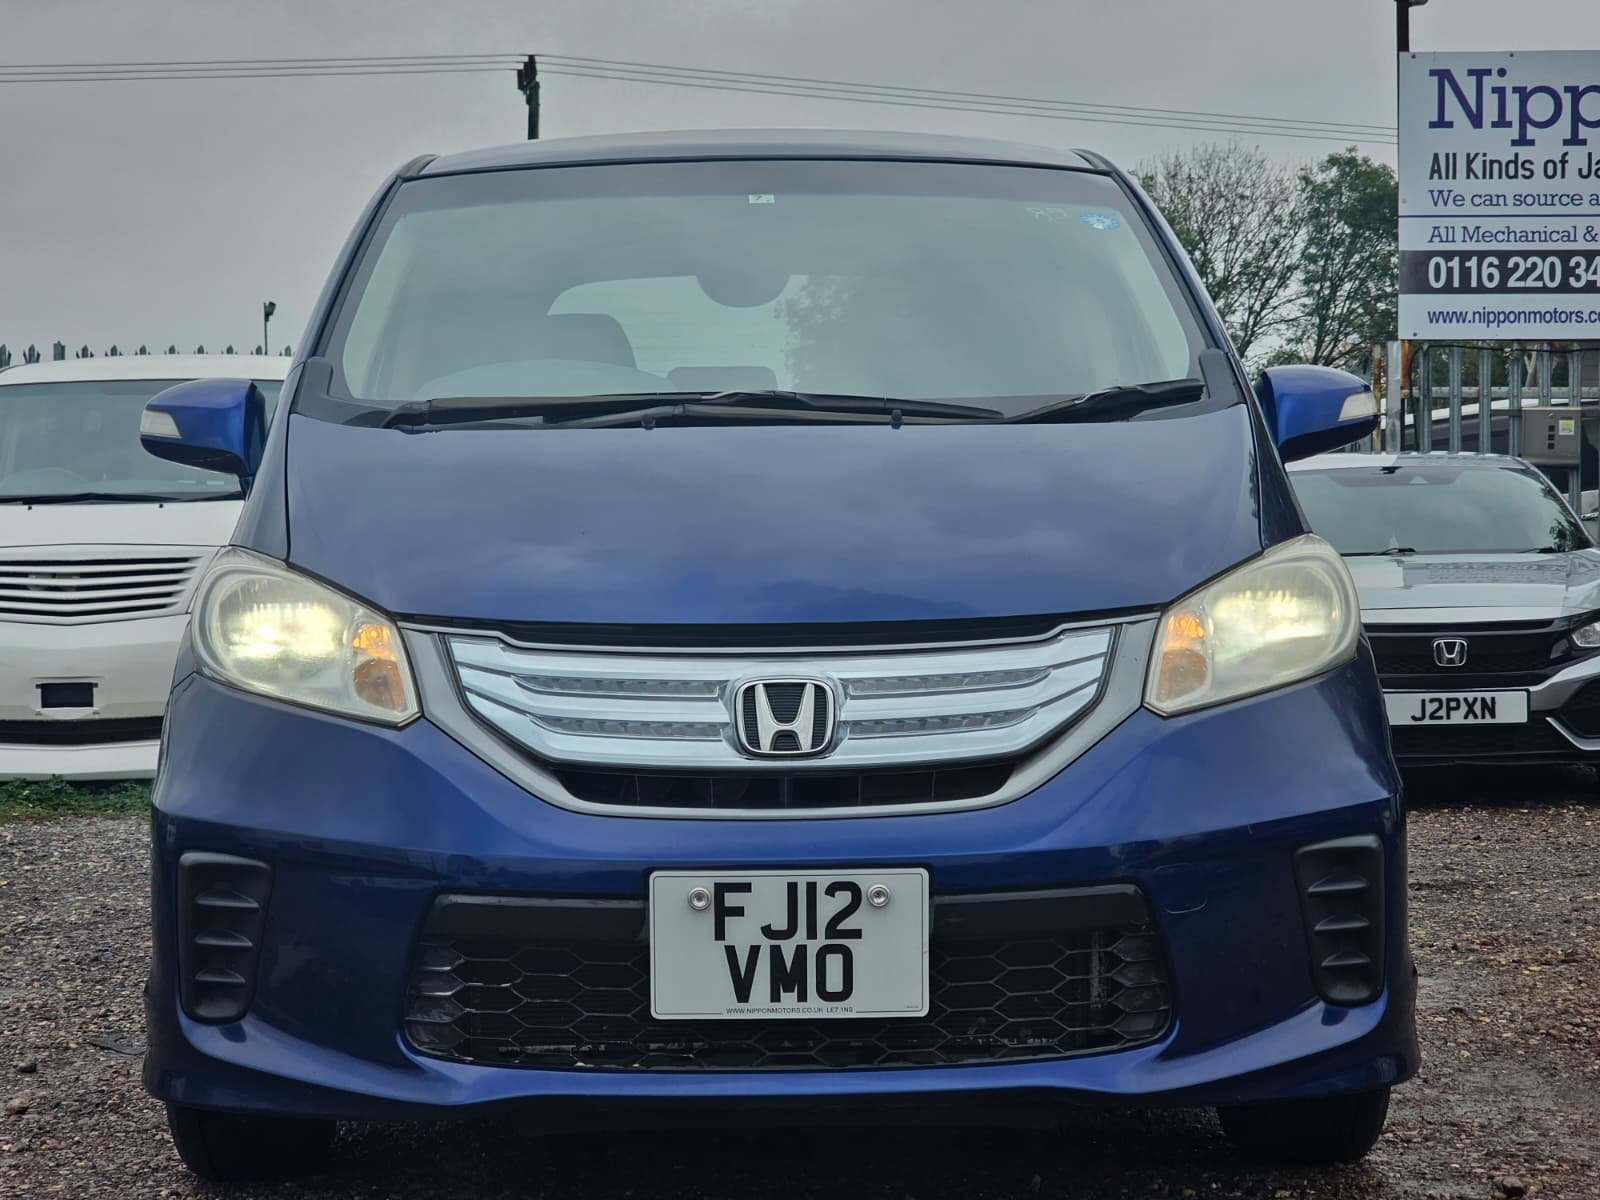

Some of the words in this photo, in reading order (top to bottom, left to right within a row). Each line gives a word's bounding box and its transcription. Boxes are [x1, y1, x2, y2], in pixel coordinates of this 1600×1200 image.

[1428, 67, 1600, 147] Nipp
[1429, 152, 1457, 180] All
[1465, 152, 1535, 180] Kinds
[1543, 151, 1569, 180] of
[1428, 189, 1465, 207] We
[1470, 192, 1507, 207] can
[1513, 192, 1583, 207] source
[1428, 226, 1456, 243] All
[1461, 225, 1579, 243] Mechanical
[1583, 225, 1599, 242] &
[1428, 256, 1500, 289] 0116
[1506, 256, 1562, 289] 220
[1569, 255, 1600, 288] 34
[1428, 306, 1600, 328] www.nipponmotors.c
[1411, 697, 1496, 721] J2PXN
[713, 880, 863, 941] FJ12
[724, 943, 853, 1003] VMO
